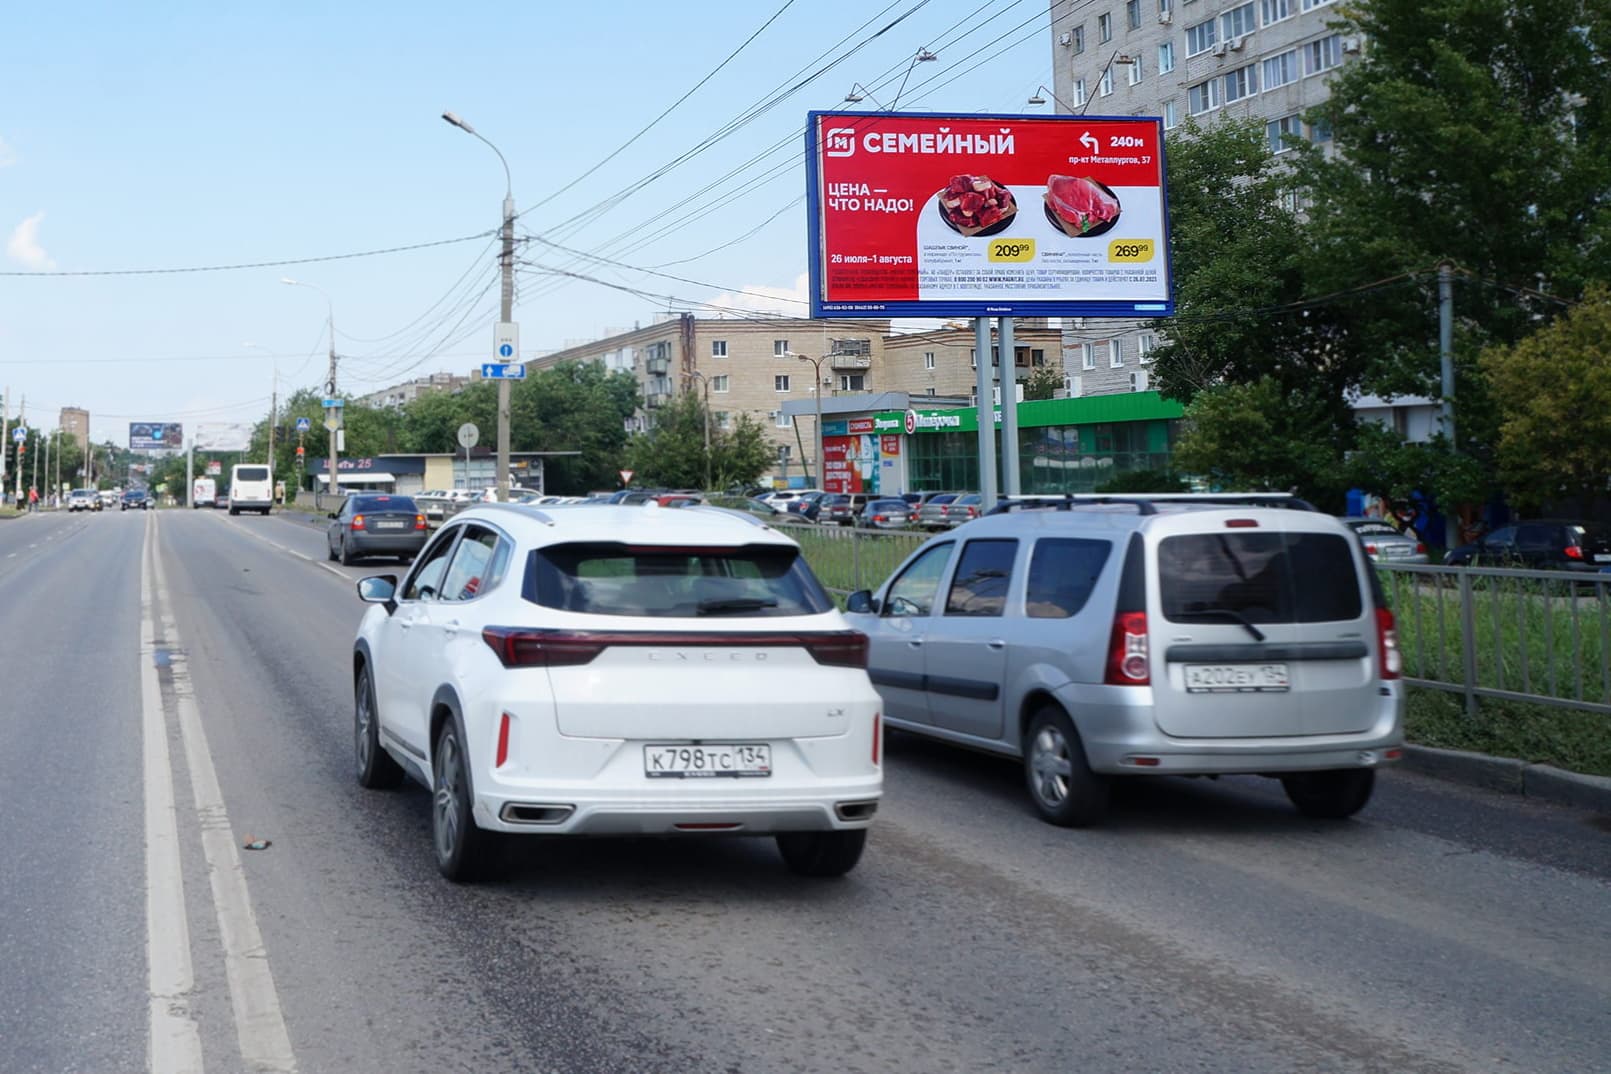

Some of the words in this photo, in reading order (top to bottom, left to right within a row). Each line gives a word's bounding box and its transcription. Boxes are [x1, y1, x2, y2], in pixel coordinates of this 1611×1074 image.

[863, 127, 1015, 155] СЕМЕЙНЫЙ
[1068, 156, 1089, 165] пр-кт
[1090, 155, 1140, 166] Металлургов,
[1141, 156, 1152, 164] 37
[828, 183, 870, 197] ЦЕНА
[828, 198, 860, 211] ЧТО
[864, 198, 914, 213] НАДО!
[831, 254, 842, 263] 26
[879, 255, 913, 265] августа
[358, 458, 373, 469] 25
[736, 748, 767, 763] 134
